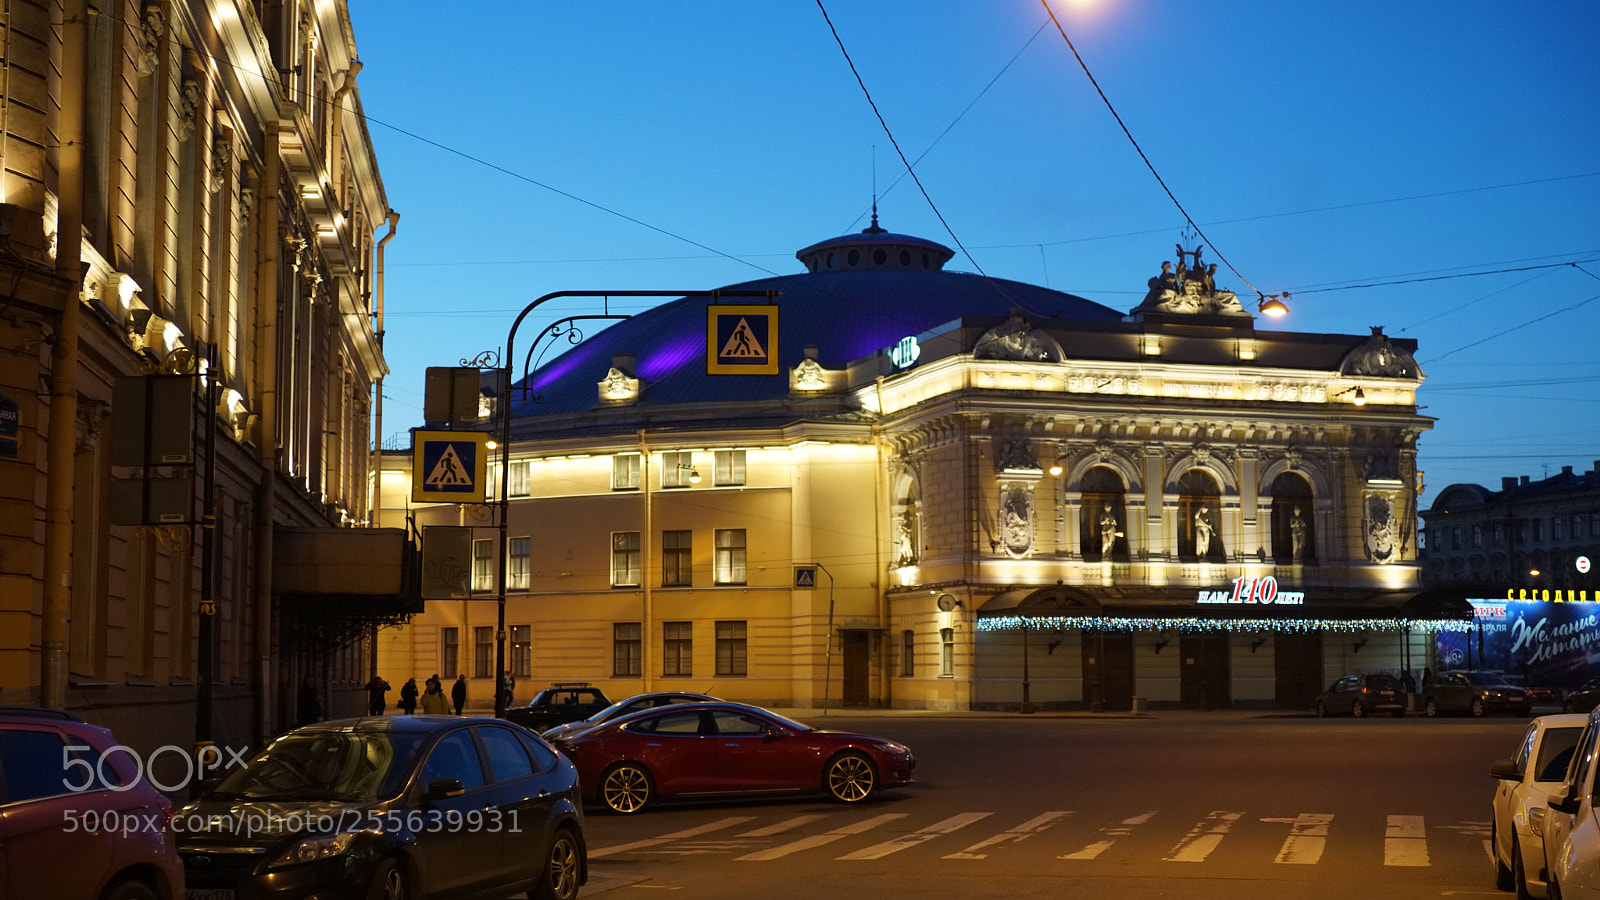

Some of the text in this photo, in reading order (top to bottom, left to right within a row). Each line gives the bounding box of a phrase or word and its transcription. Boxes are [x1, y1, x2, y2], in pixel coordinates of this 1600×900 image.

[1197, 575, 1305, 605] НАМ 140 ЛЕТ!
